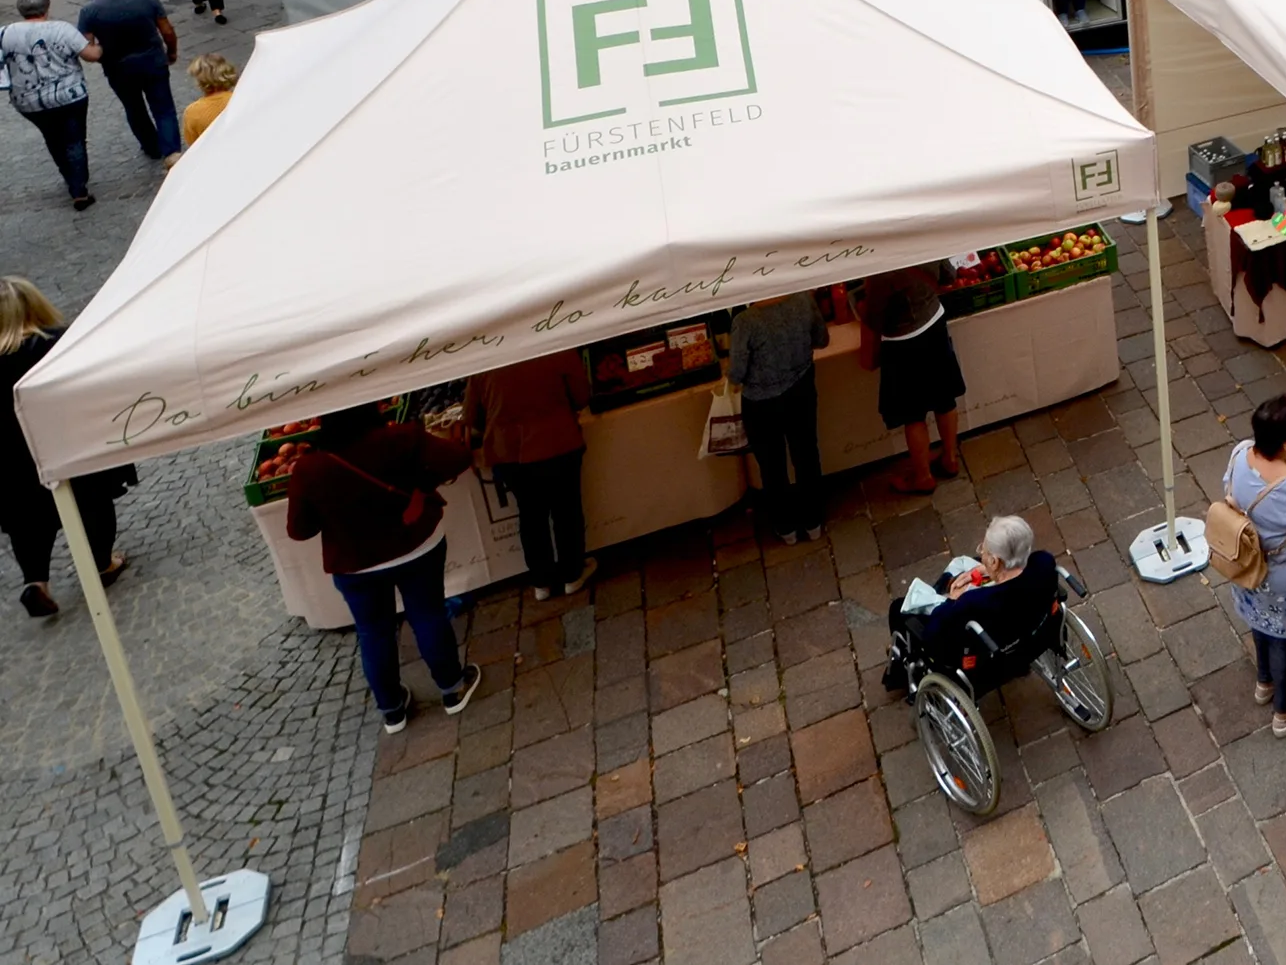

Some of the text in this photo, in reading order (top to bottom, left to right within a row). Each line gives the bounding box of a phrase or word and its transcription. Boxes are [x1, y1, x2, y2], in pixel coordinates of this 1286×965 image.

[544, 104, 763, 157] FÜRSTENFELD
[545, 135, 692, 174] bauernmarkt
[226, 372, 327, 410] bin
[351, 351, 378, 378] i
[400, 335, 505, 363] her,
[531, 300, 594, 332] do
[613, 256, 737, 309] kauf
[753, 250, 778, 276] i
[794, 239, 875, 268] ein.
